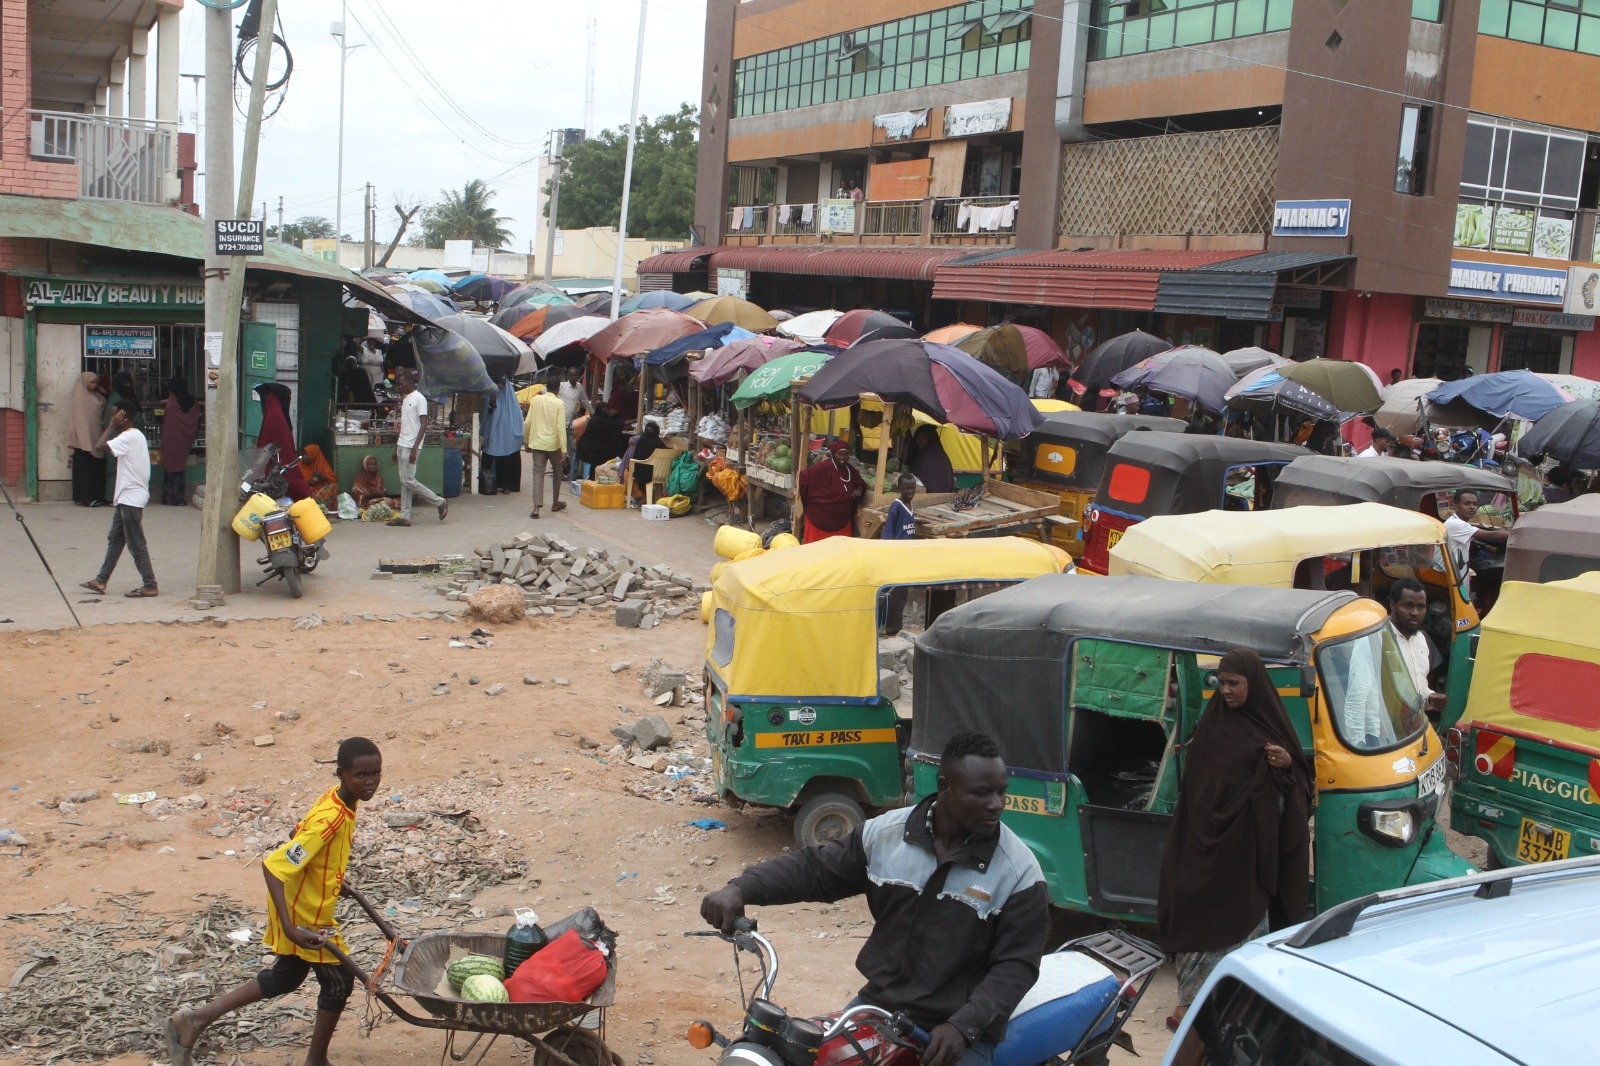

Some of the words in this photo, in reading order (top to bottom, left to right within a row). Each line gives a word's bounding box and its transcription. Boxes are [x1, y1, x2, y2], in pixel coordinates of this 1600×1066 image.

[1274, 207, 1347, 228] PHARMACY
[217, 221, 260, 233] SUCDI
[1496, 229, 1512, 237] BUY
[219, 234, 260, 243] INSURANCE
[1451, 268, 1501, 292] MARKAZ
[107, 285, 172, 304] BEAUTY
[174, 286, 206, 304] HUB
[1427, 299, 1464, 310] MARKAZ
[1468, 303, 1514, 314] PHARMACY
[1513, 312, 1550, 325] MARKAZ
[1550, 316, 1595, 328] PHARMACY
[757, 367, 781, 377] FOR
[749, 377, 774, 389] YOU
[782, 732, 810, 747] TAXI
[816, 732, 824, 744] 3
[830, 730, 862, 744] PASS
[1005, 795, 1039, 812] PASS
